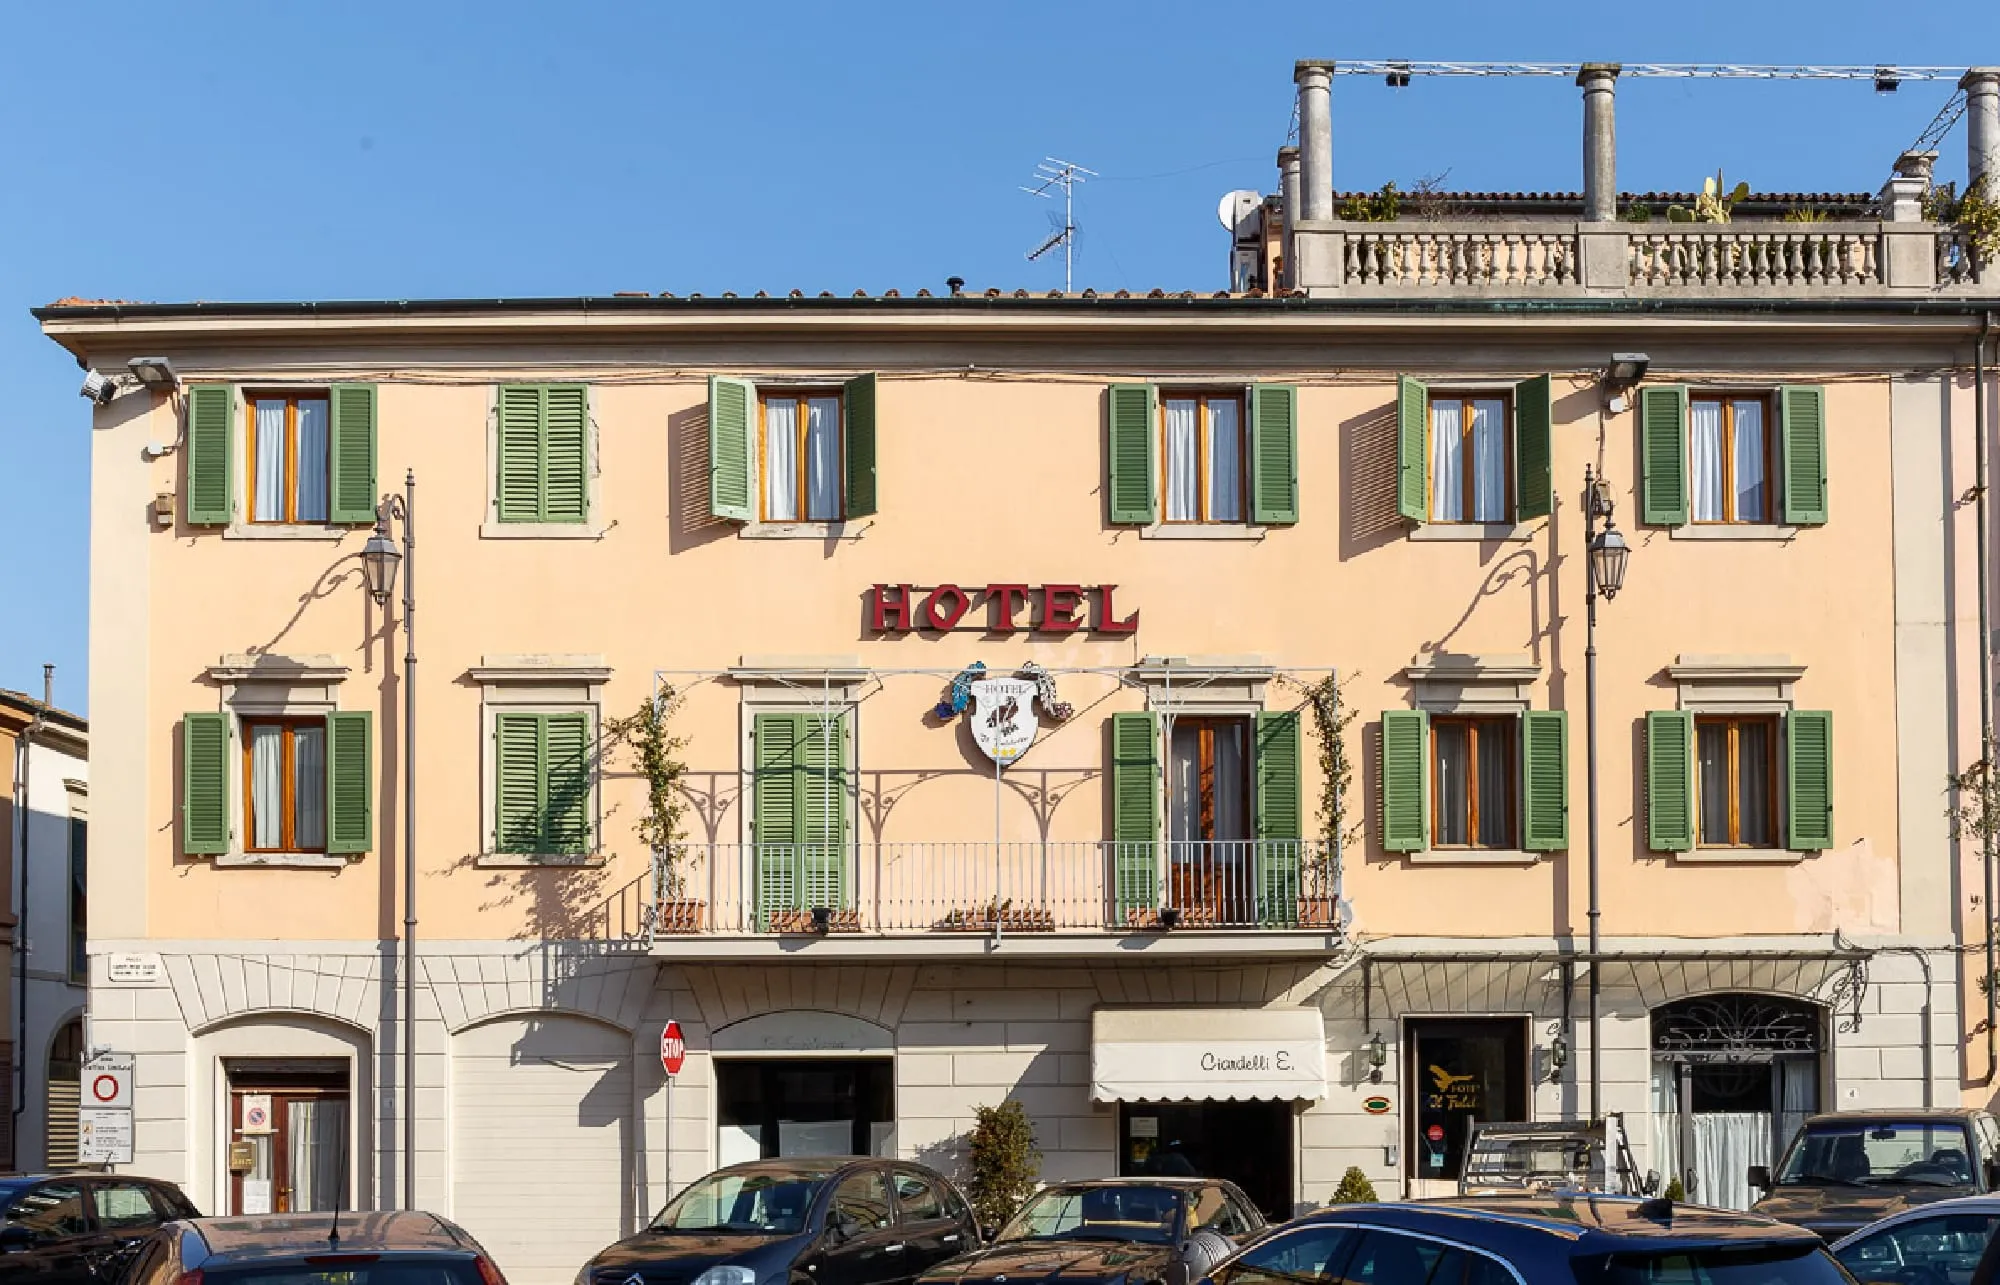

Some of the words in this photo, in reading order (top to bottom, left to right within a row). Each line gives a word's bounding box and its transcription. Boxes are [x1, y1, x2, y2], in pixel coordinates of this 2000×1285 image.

[872, 583, 1140, 633] HOTEL
[985, 684, 1026, 694] HOTEL
[663, 1037, 684, 1059] STOP
[1200, 1051, 1270, 1071] Ciardelli
[1276, 1050, 1295, 1071] E.
